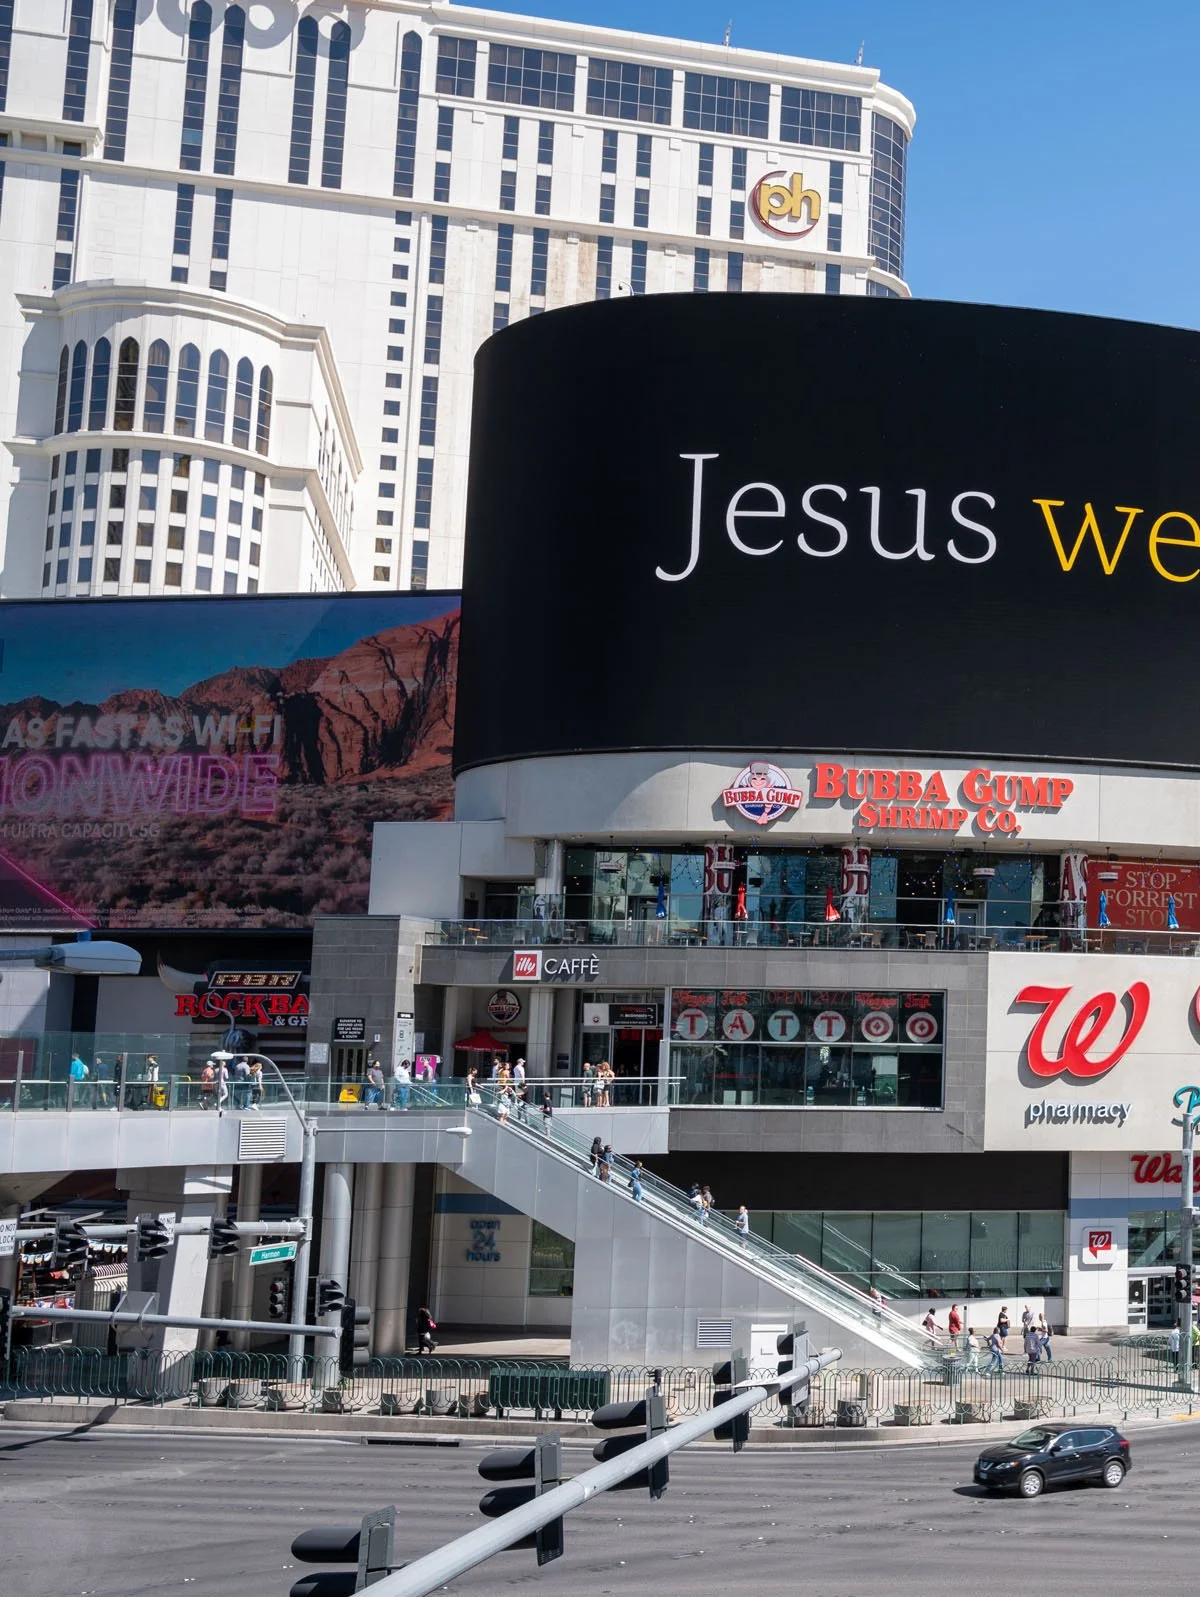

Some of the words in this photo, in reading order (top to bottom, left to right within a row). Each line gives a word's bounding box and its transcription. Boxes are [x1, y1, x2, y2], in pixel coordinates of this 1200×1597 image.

[656, 454, 997, 583] Jesus
[2, 715, 46, 748] AS
[56, 714, 137, 748] FAST
[140, 714, 185, 748] AS
[192, 713, 281, 746] WI-FI
[813, 763, 951, 802] BUBBA
[963, 768, 1074, 807] GUMP
[724, 790, 764, 804] BUBBA
[766, 788, 800, 805] GUMP
[859, 802, 968, 831] SHRIMP
[976, 806, 1022, 833] CO.
[11, 823, 57, 839] ULTRA
[61, 823, 133, 839] CAPACITY
[139, 823, 161, 839] 5G
[1125, 870, 1177, 889] STOP
[1104, 888, 1198, 909] FORREST
[1125, 909, 1172, 928] STO
[516, 957, 536, 975] illy
[544, 953, 600, 975] CAFFÈ
[216, 974, 295, 986] PBR
[767, 991, 803, 1005] OPEN
[175, 992, 310, 1026] ROCKBA
[274, 1016, 286, 1026] &
[1030, 1100, 1133, 1120] pharmacy
[5, 1223, 16, 1232] NOT
[0, 1236, 15, 1244] LOCK
